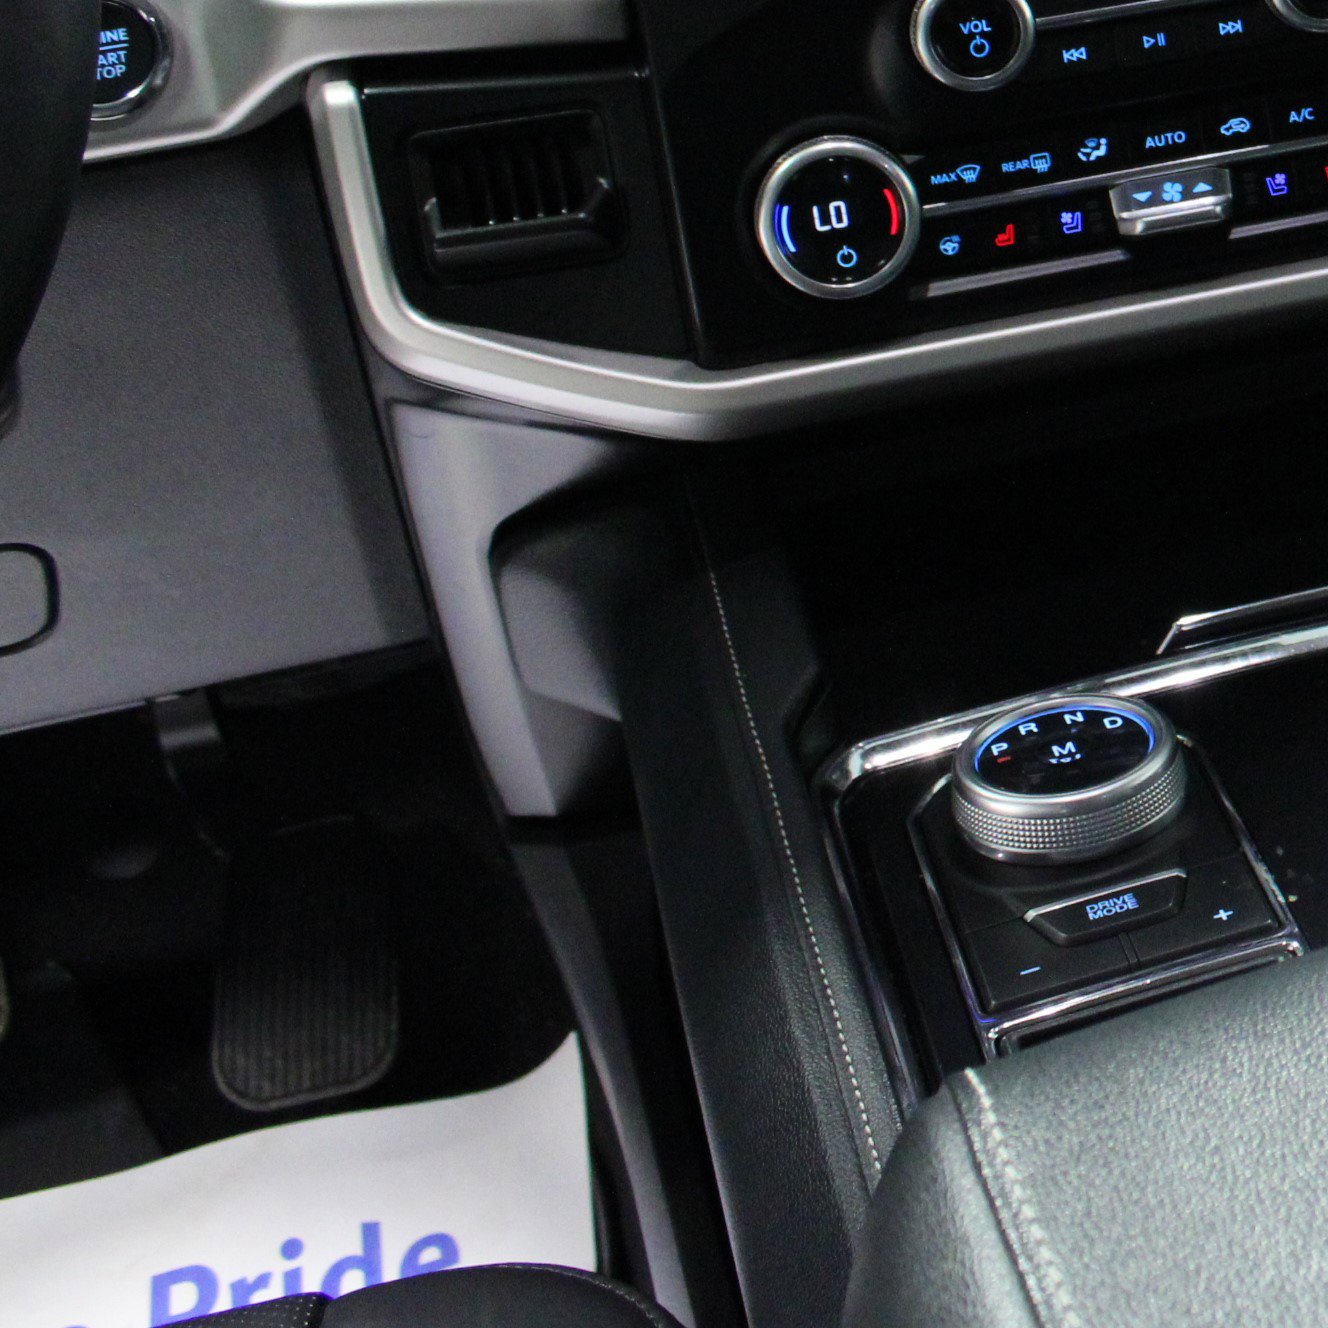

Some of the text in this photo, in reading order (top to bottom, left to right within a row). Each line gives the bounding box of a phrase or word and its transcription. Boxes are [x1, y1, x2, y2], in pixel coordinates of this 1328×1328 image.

[959, 19, 991, 35] VOL
[99, 28, 129, 43] INE
[97, 51, 128, 66] ART
[96, 65, 126, 81] TOP
[1288, 107, 1315, 124] A/C
[1145, 130, 1186, 150] AUTO
[1001, 159, 1030, 173] REAR
[930, 171, 957, 185] MAX
[812, 201, 849, 232] LO
[990, 711, 1123, 756] P R N D
[1051, 741, 1077, 757] M
[1085, 893, 1134, 913] DRIVE
[1088, 899, 1139, 920] MODE
